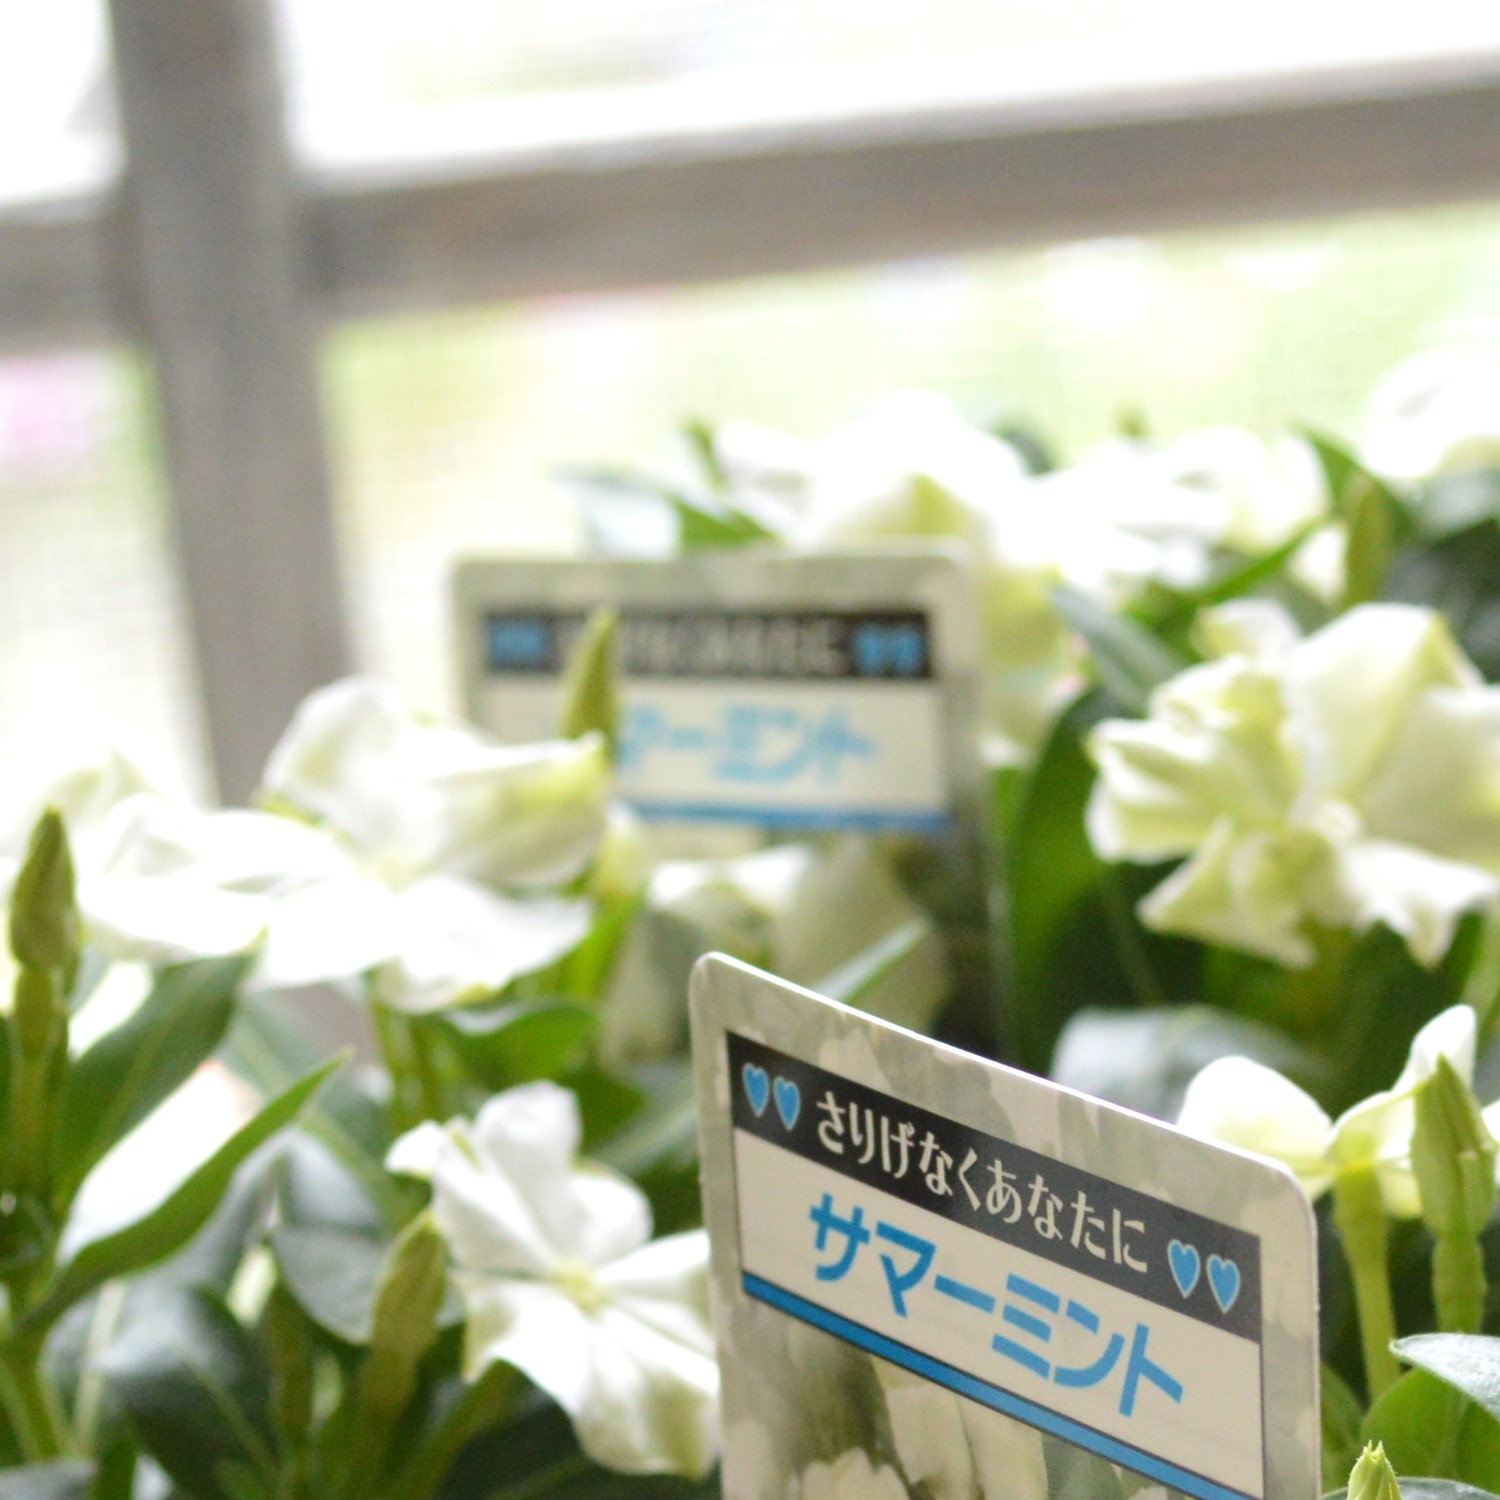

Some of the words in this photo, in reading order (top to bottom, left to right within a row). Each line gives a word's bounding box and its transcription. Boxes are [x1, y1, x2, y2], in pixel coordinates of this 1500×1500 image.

[816, 1091, 1149, 1274] さりげなくあなたに
[808, 1193, 1184, 1418] サマーミント
